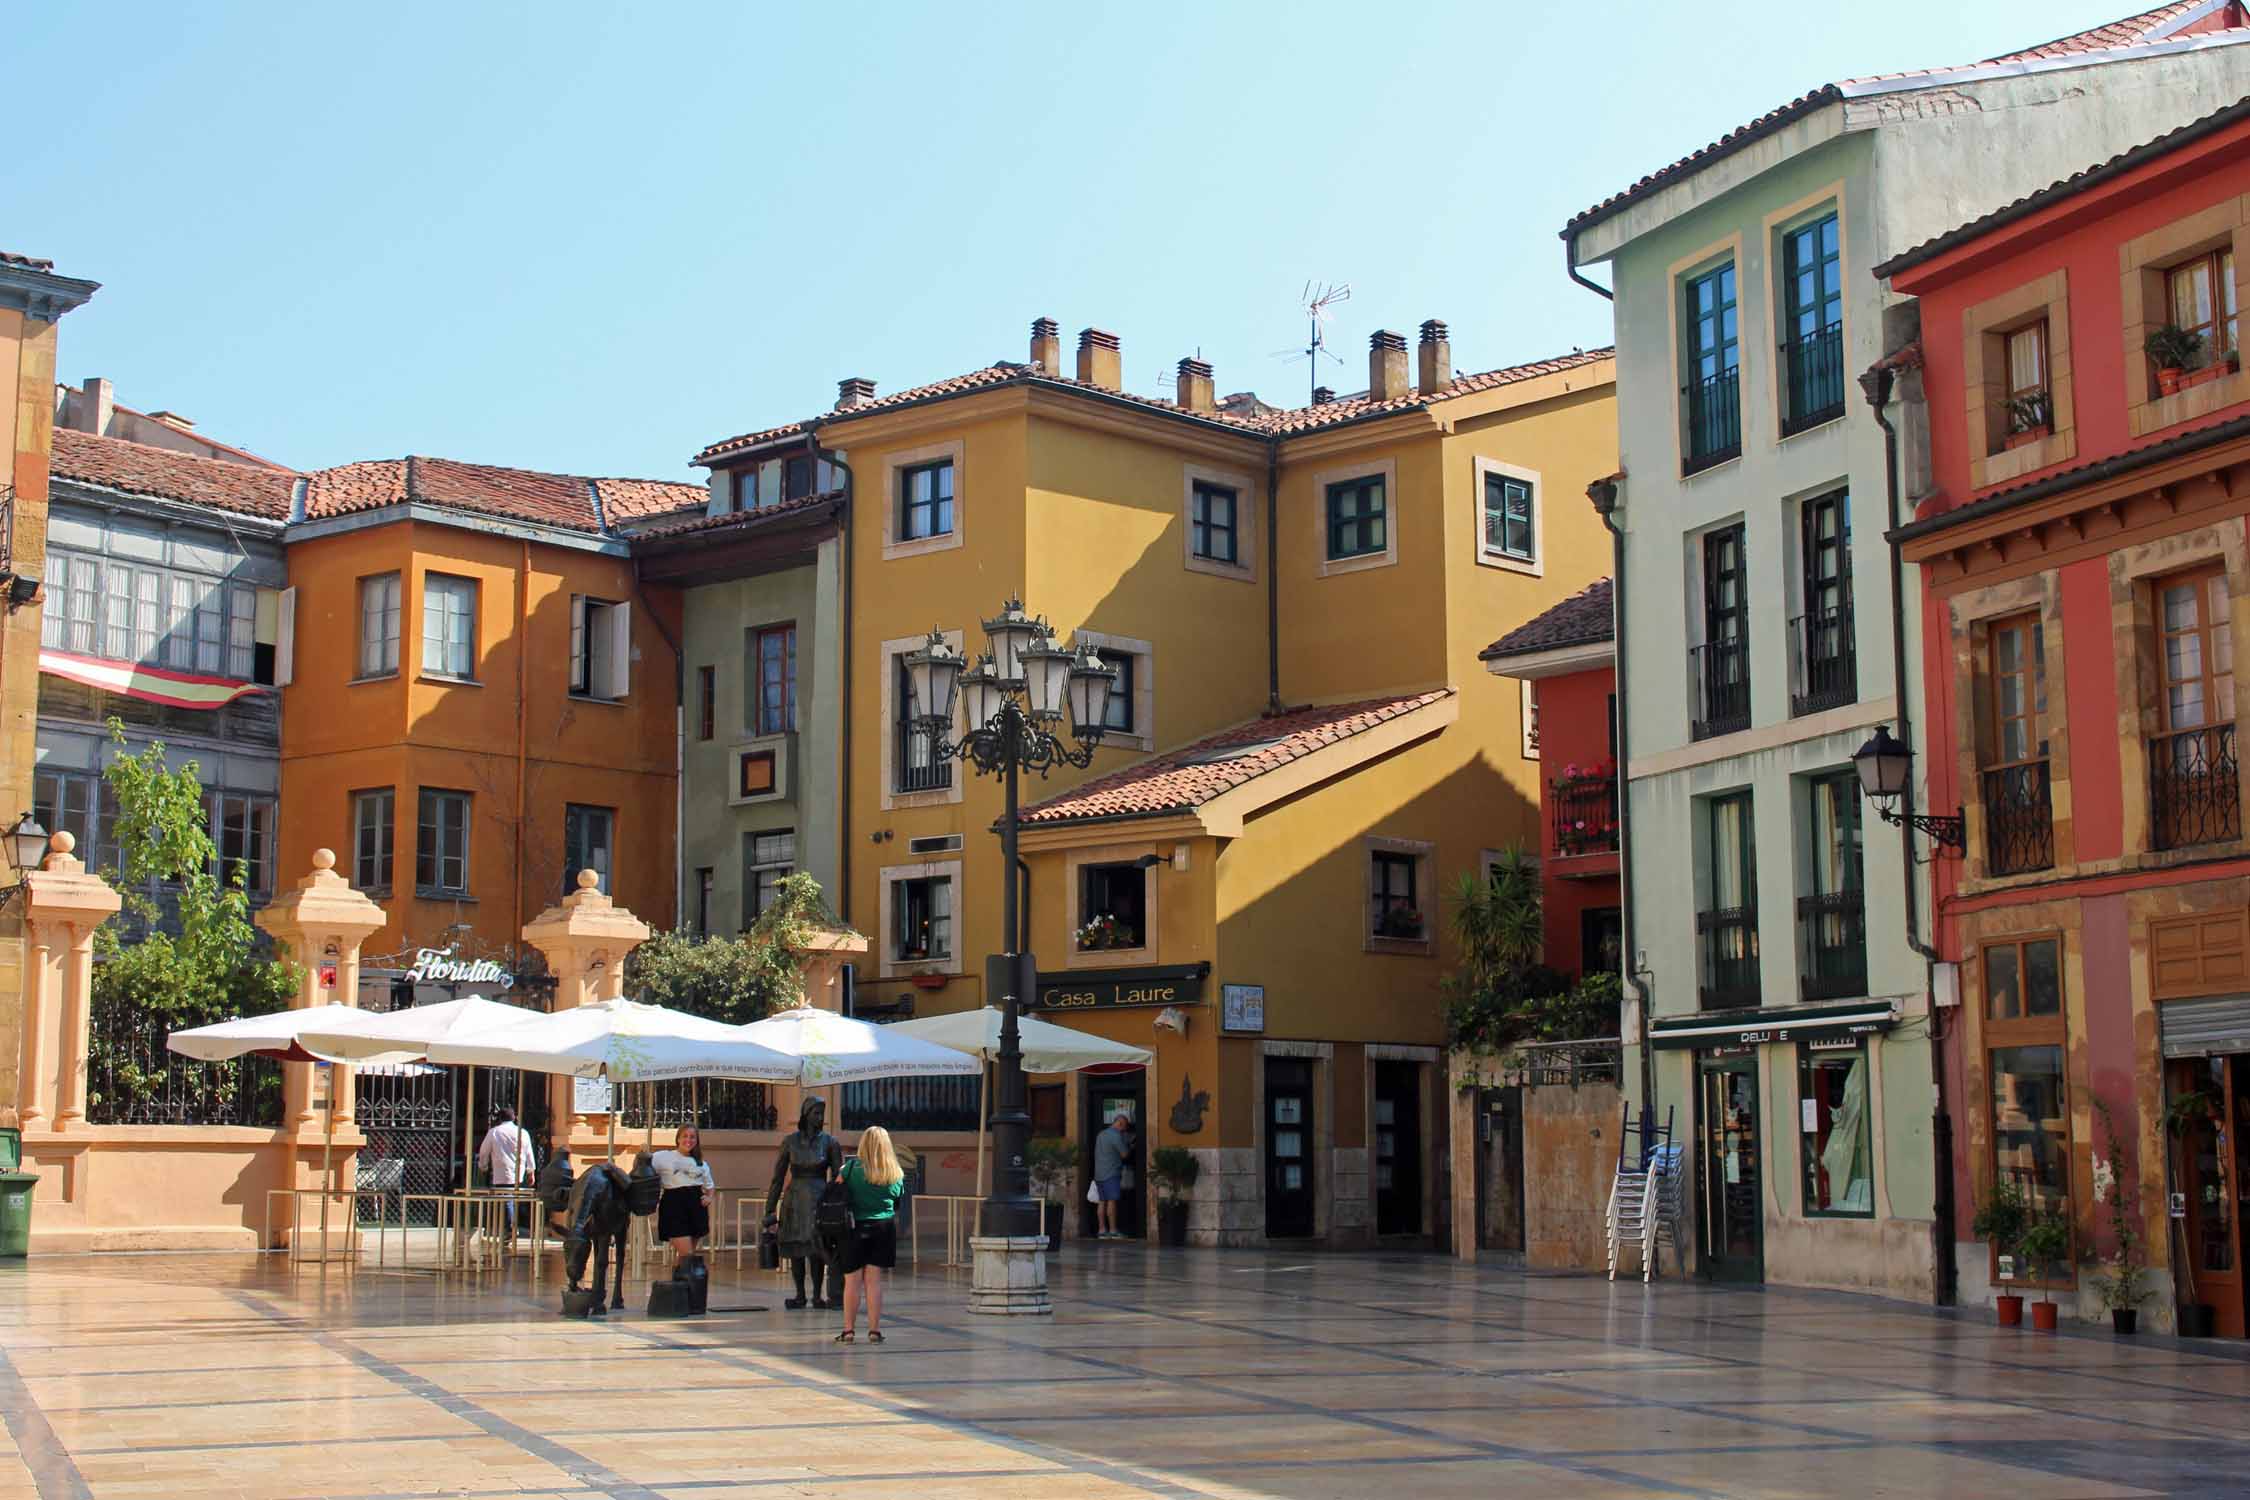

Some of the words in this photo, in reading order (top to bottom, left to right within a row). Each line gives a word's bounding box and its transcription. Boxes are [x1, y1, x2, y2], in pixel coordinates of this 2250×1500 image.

[404, 948, 503, 983] Floridita
[1044, 988, 1096, 1007] Casa
[1115, 985, 1175, 1003] Laure
